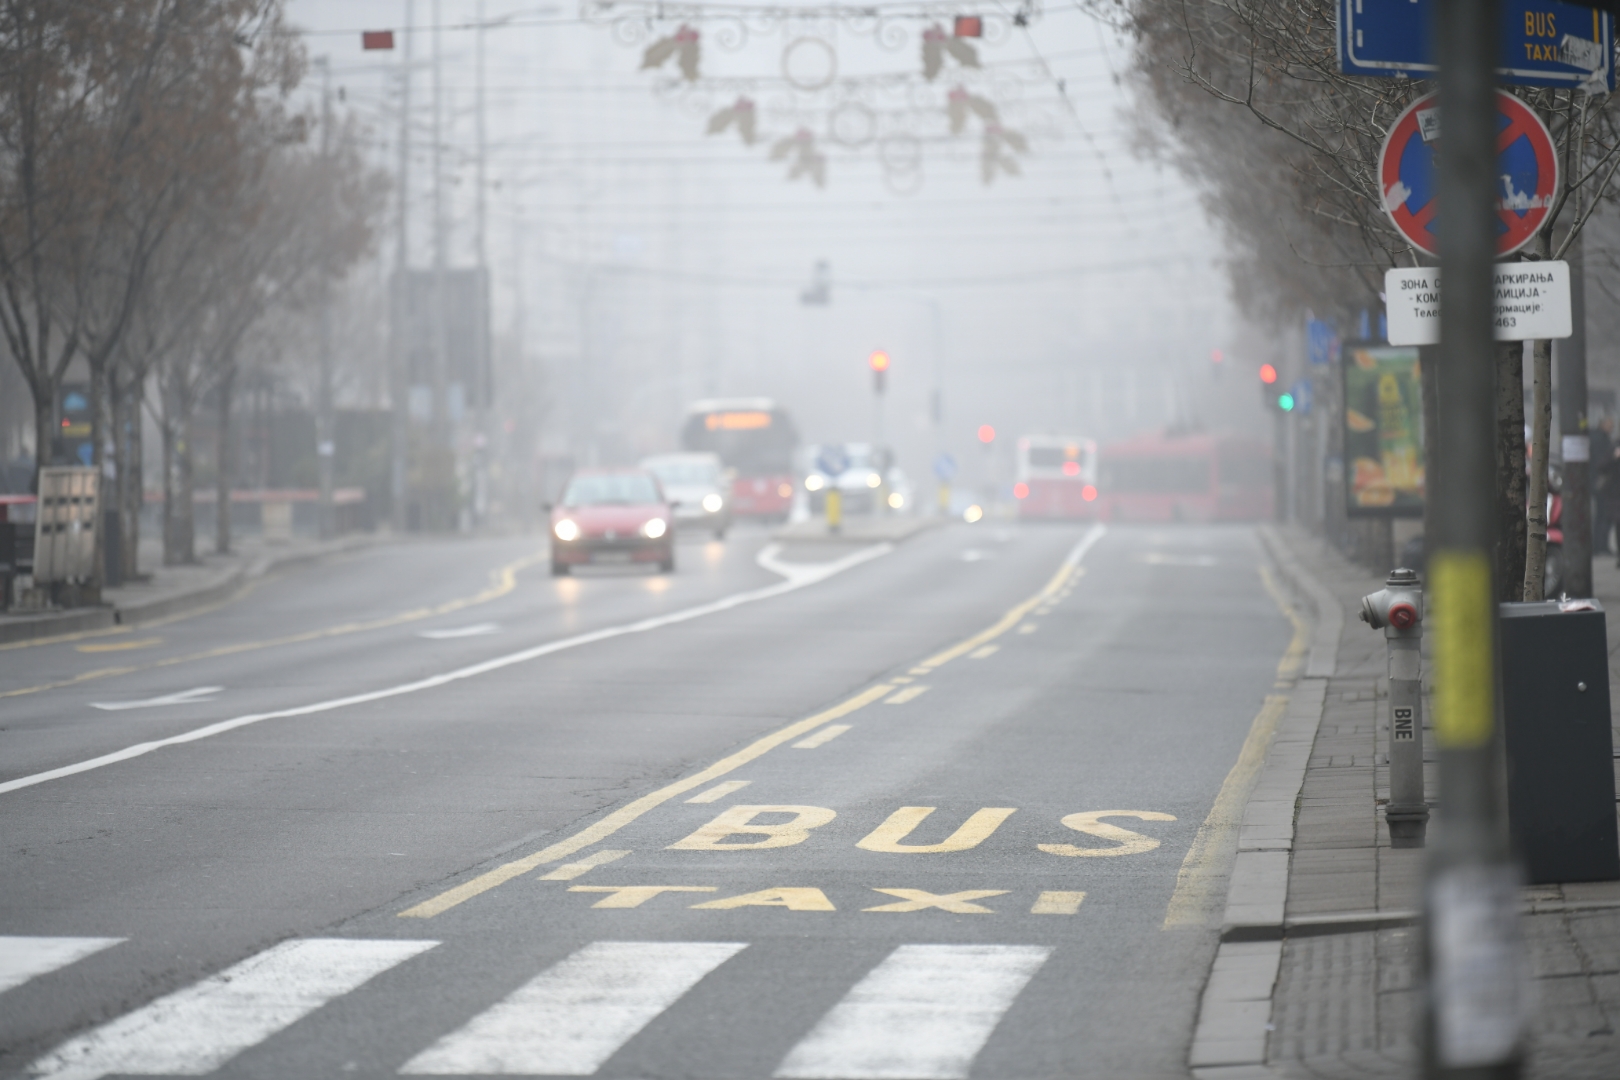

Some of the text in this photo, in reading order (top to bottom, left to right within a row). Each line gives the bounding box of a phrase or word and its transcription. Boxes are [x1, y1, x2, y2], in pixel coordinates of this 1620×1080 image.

[1525, 11, 1556, 38] BUS
[1524, 43, 1558, 61] TAXI
[1401, 279, 1428, 290] ЗОНА
[1495, 272, 1554, 284] АРКИРАЊА
[1496, 287, 1539, 299] ЛИЦИЈА
[1493, 302, 1544, 315] ормације:
[1495, 316, 1516, 327] 463
[1395, 708, 1413, 739] BNE
[666, 804, 1178, 858] BUS
[567, 885, 1087, 914] TAXI
